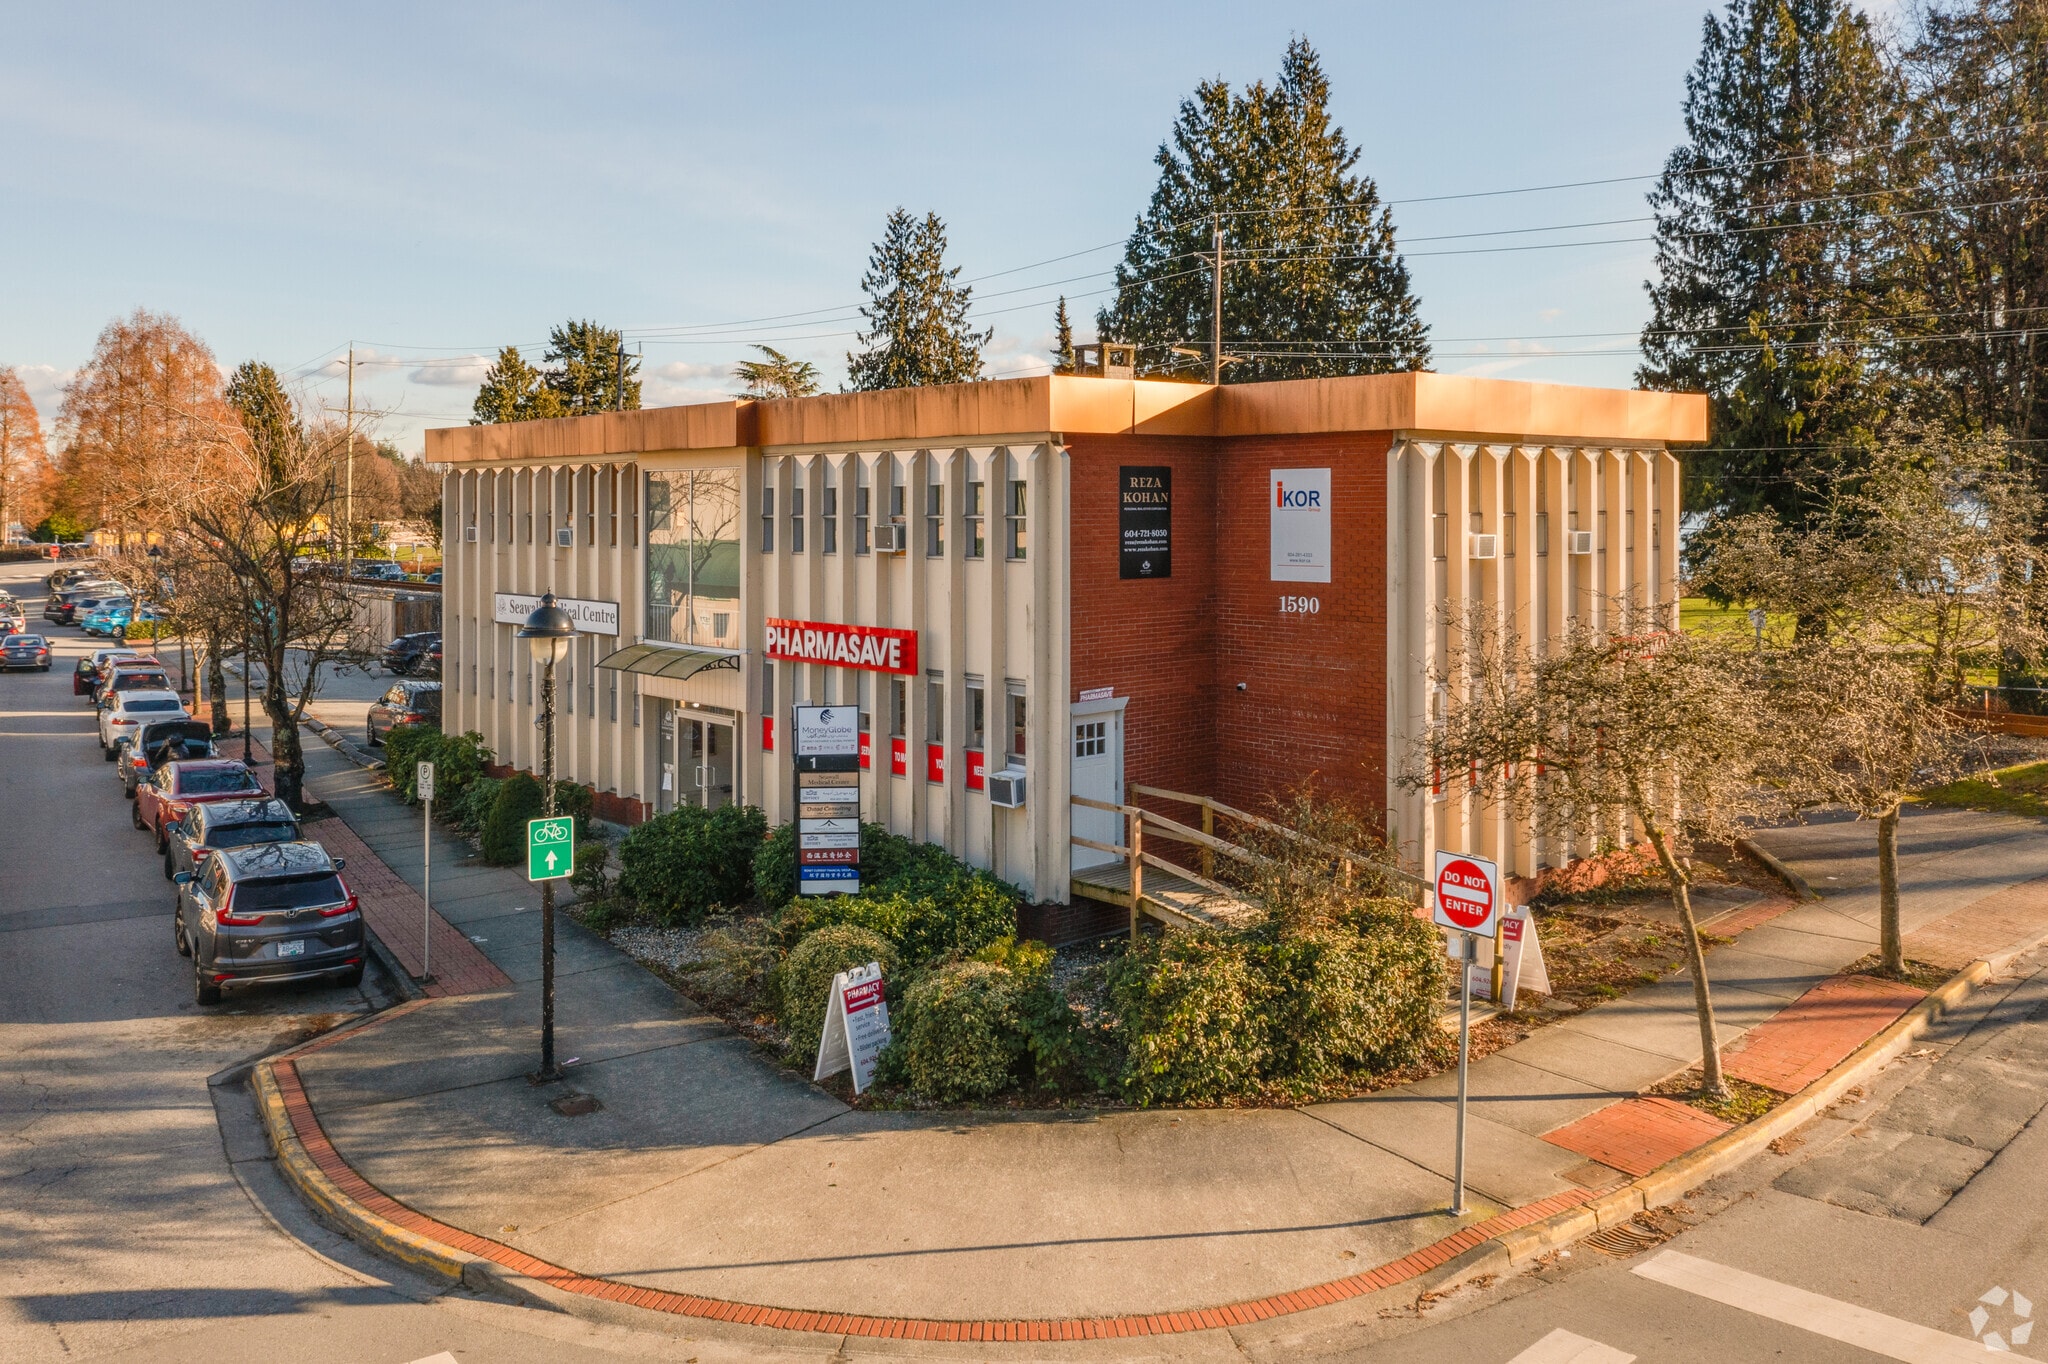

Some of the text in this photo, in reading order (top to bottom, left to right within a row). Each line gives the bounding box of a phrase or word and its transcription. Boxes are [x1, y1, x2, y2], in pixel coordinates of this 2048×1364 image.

[1129, 476, 1162, 488] REZA
[1122, 491, 1169, 503] KOHAN
[1278, 595, 1320, 614] 1590
[583, 605, 616, 624] Centre
[765, 626, 901, 669] PHARMASAVE
[1079, 691, 1113, 702] PHARMASAVE
[802, 726, 852, 735] MoneyGlobe
[809, 757, 816, 769] 1
[1444, 871, 1487, 889] DO NOT
[1446, 899, 1483, 917] ENTER
[847, 981, 880, 1000] PHARMACY
